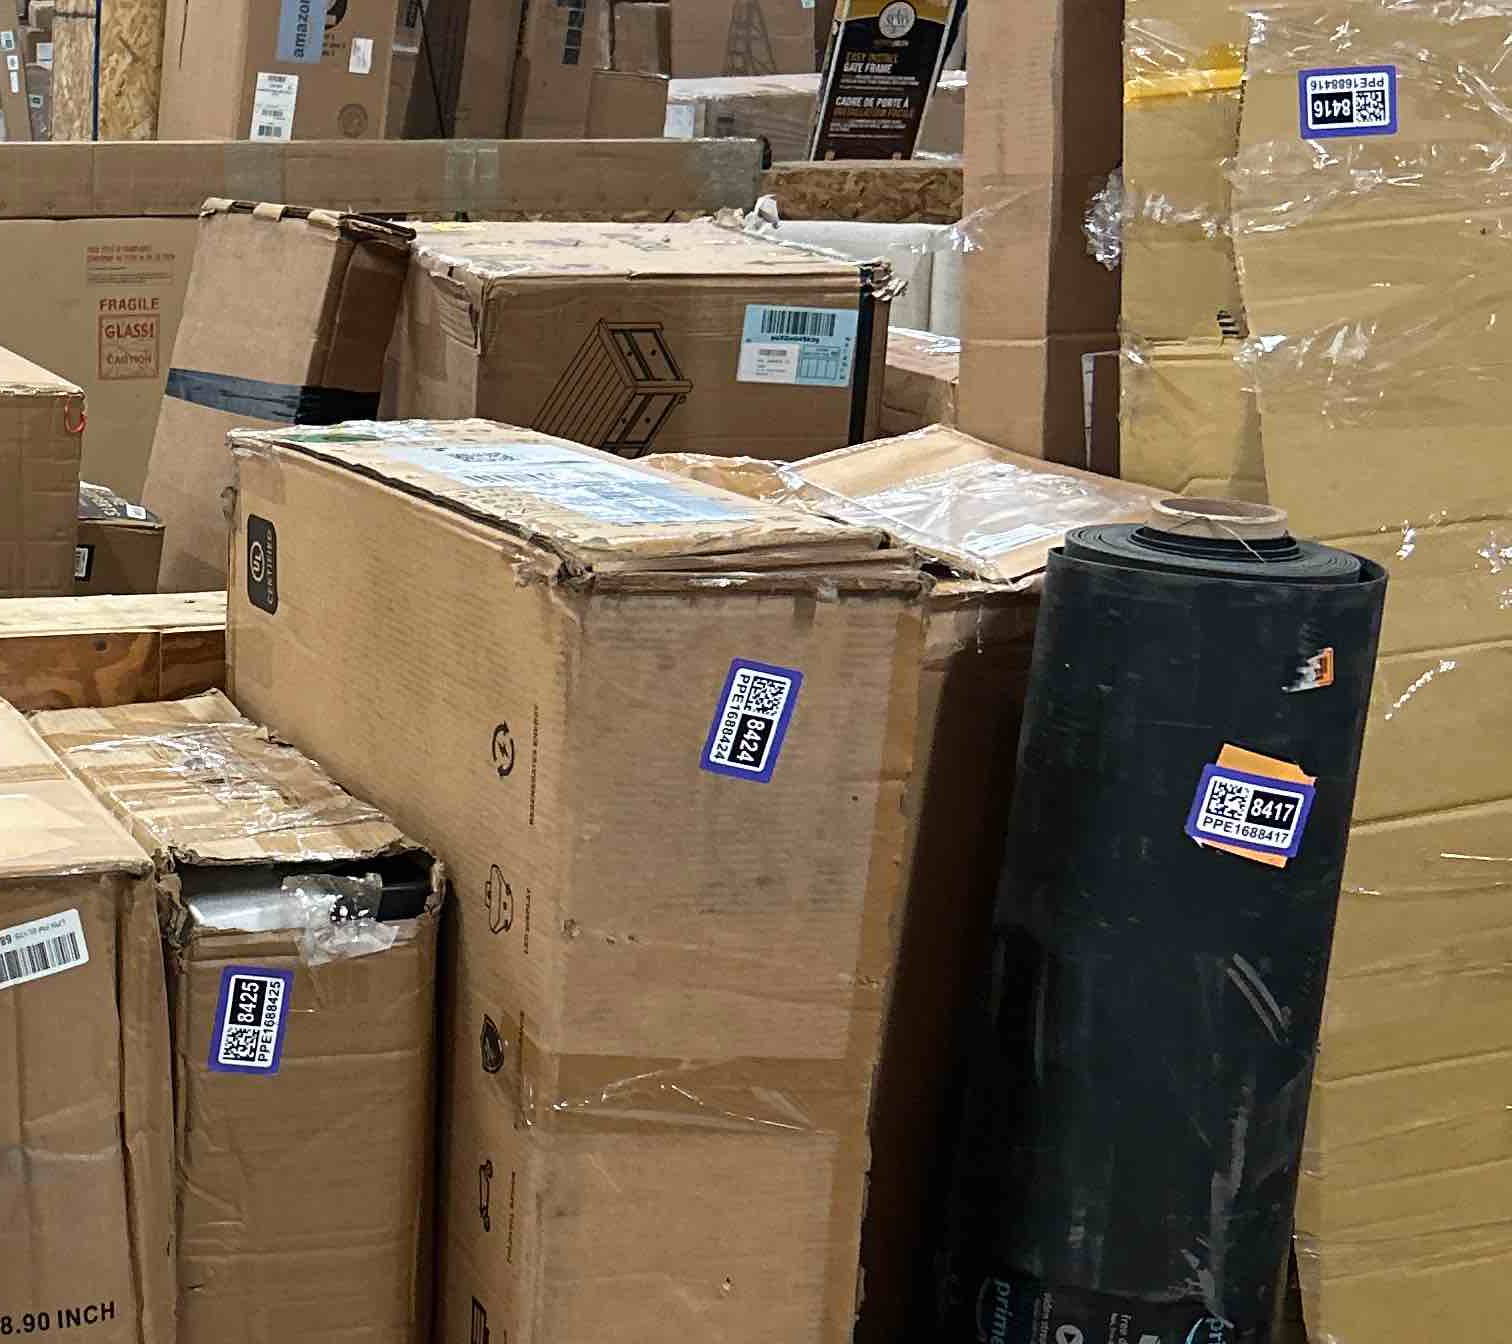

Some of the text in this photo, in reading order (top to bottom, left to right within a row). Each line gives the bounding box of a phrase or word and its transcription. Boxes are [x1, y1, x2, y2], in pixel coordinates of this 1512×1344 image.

[1310, 79, 1385, 91] PPE1688416
[1313, 99, 1351, 118] 8416
[99, 298, 160, 311] FRAGILE
[714, 674, 750, 760] PPE1688424
[736, 718, 765, 762] 8424
[1251, 798, 1294, 822] 8417
[1203, 816, 1289, 843] PPE1688417
[237, 982, 259, 1023] 8425
[258, 981, 281, 1061] PPE1688425
[57, 1300, 115, 1329] INCH
